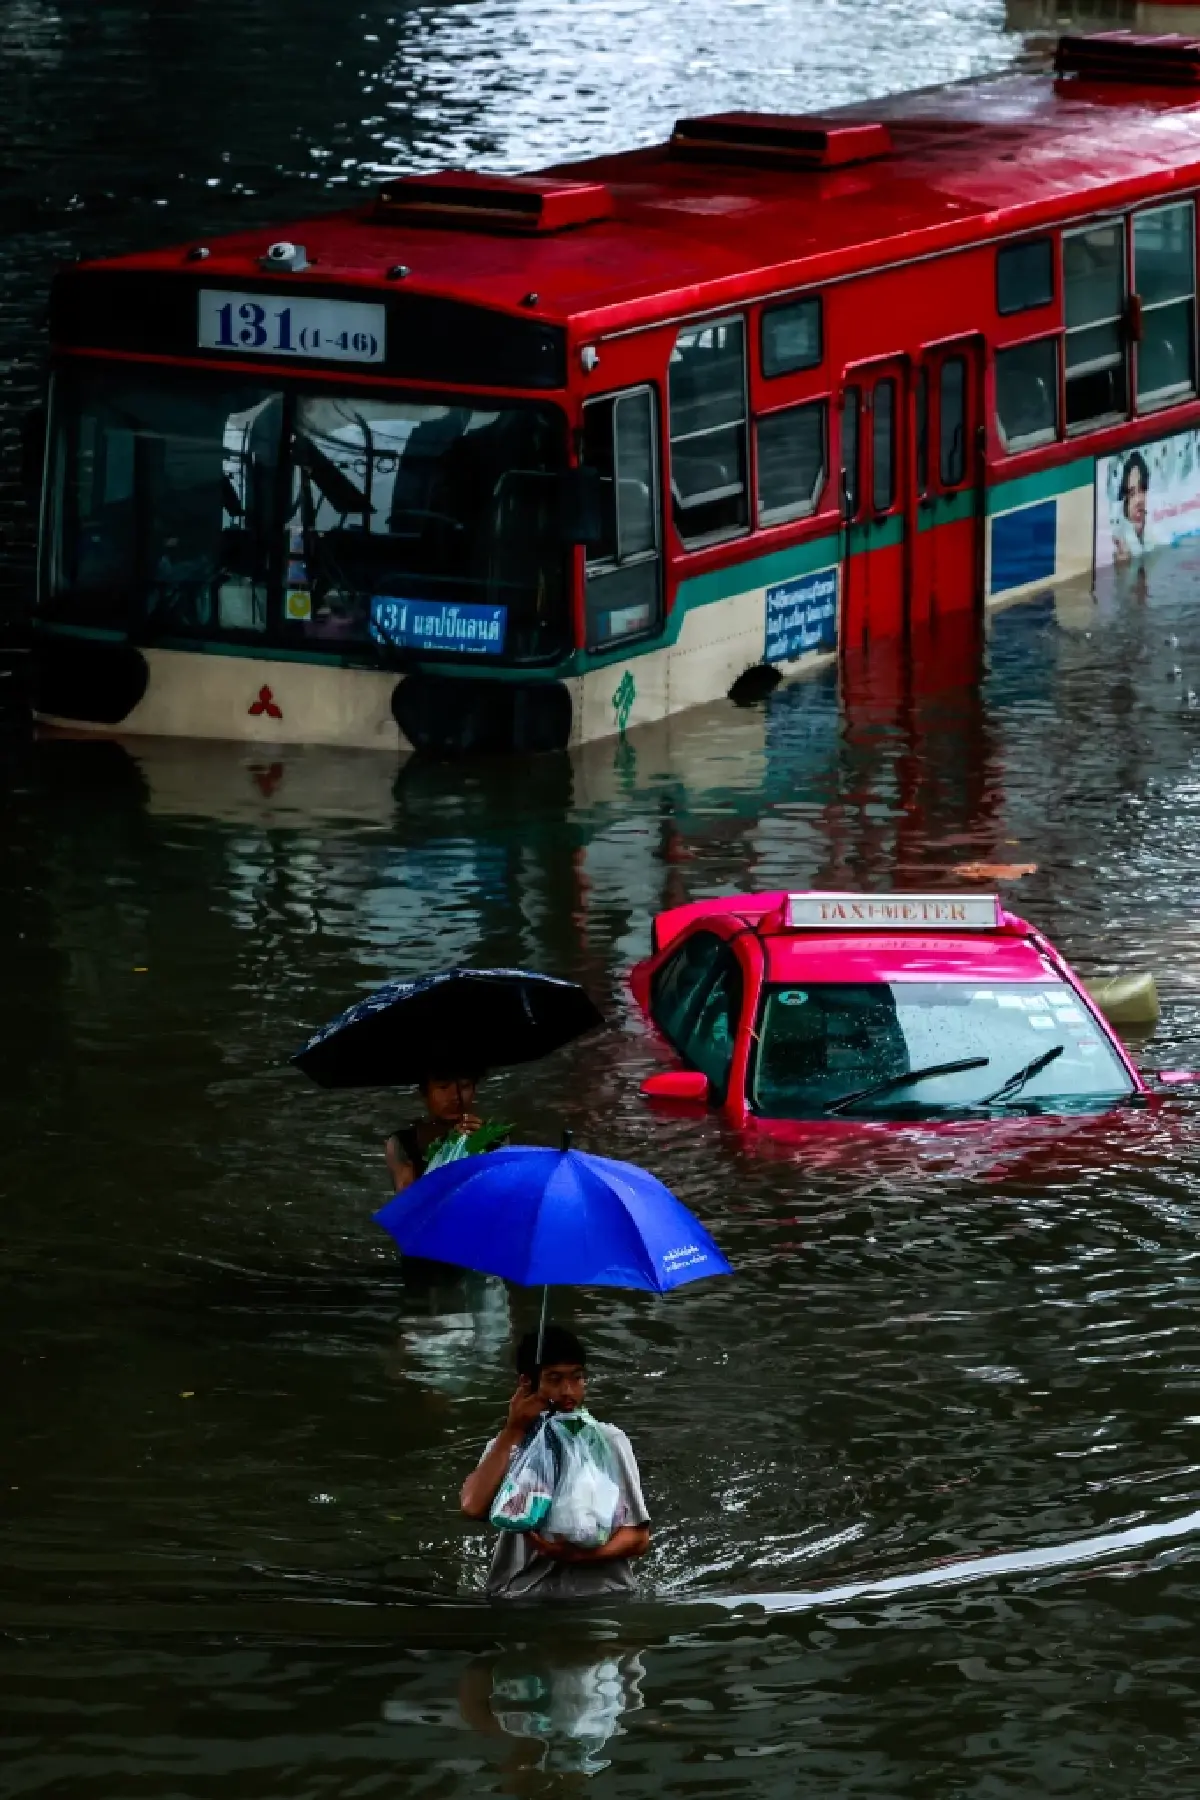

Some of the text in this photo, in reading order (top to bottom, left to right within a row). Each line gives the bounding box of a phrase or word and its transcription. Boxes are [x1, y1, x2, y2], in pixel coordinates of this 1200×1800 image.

[215, 303, 378, 357] 131 (1-46)
[819, 902, 966, 921] TAXI-METER
